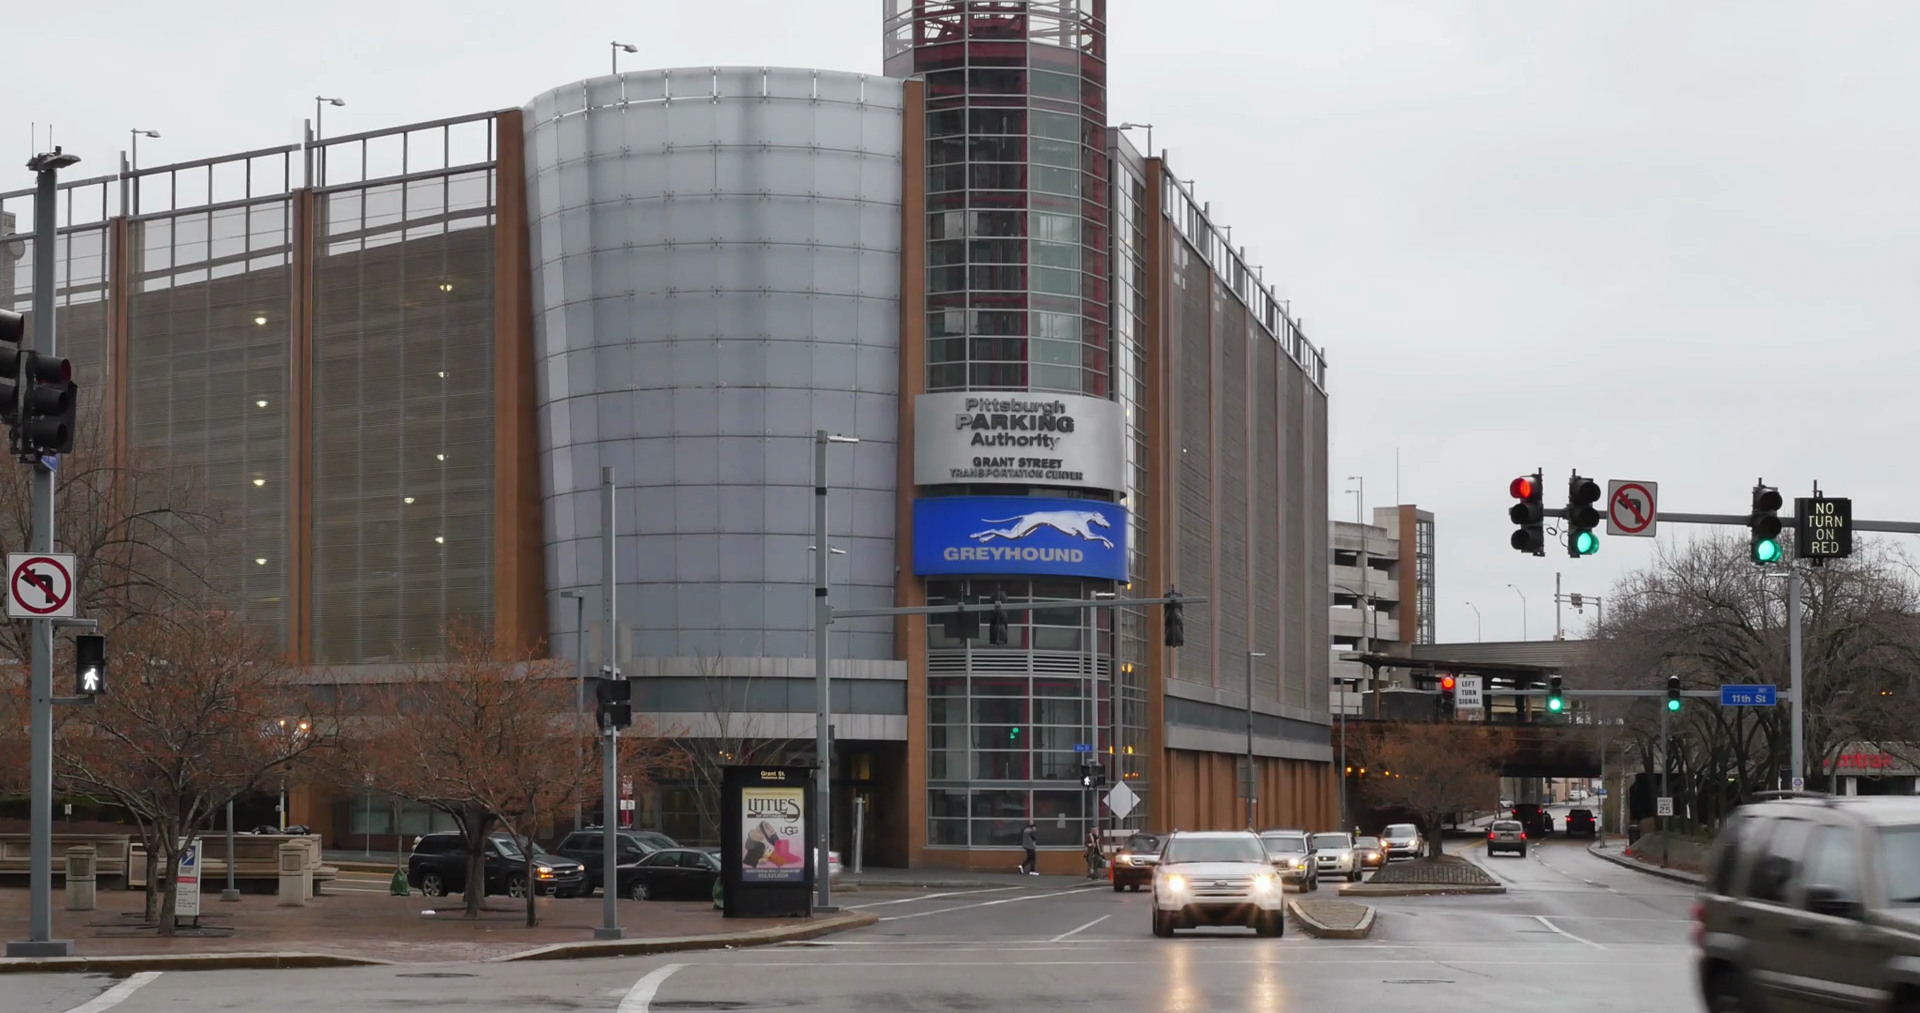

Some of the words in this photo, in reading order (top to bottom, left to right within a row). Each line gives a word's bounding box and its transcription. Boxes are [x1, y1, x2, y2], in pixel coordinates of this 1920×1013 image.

[965, 398, 1066, 416] Pittsburgh
[956, 413, 1075, 433] PARKING
[970, 432, 1061, 451] Authority
[973, 456, 1016, 468] GRANT
[1018, 457, 1064, 469] STREET
[949, 468, 1044, 479] TRANSPORTATION
[1046, 470, 1084, 480] CENTER
[1816, 502, 1834, 514] NO
[1808, 515, 1843, 527] TURN
[1816, 528, 1834, 540] ON
[1811, 541, 1839, 553] RED
[943, 547, 1084, 563] GREYHOUND
[1731, 694, 1751, 703] 11th
[1755, 694, 1766, 703] St
[1659, 806, 1671, 814] 25
[780, 826, 798, 835] UGG
